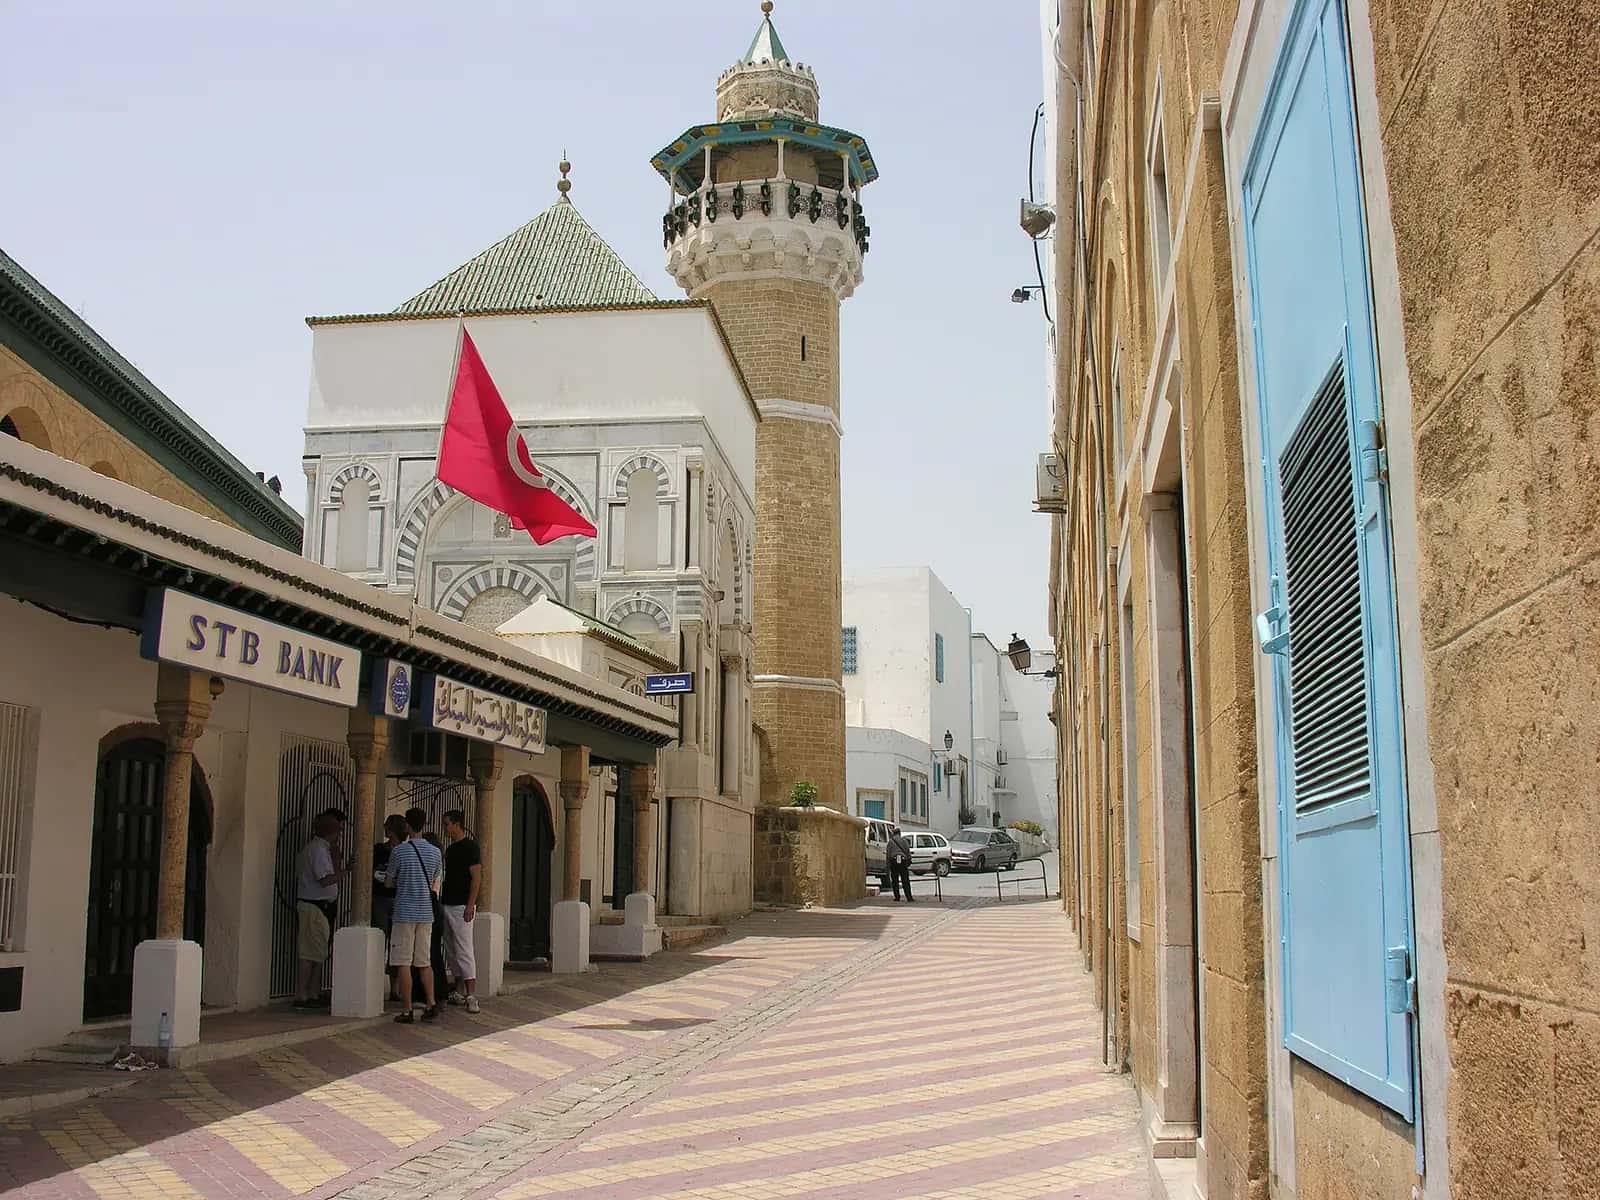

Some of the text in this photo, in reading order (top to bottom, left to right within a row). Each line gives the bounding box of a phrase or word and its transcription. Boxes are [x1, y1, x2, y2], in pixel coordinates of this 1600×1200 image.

[186, 614, 260, 665] STB
[276, 640, 344, 689] BANK
[650, 677, 686, 689] صرف
